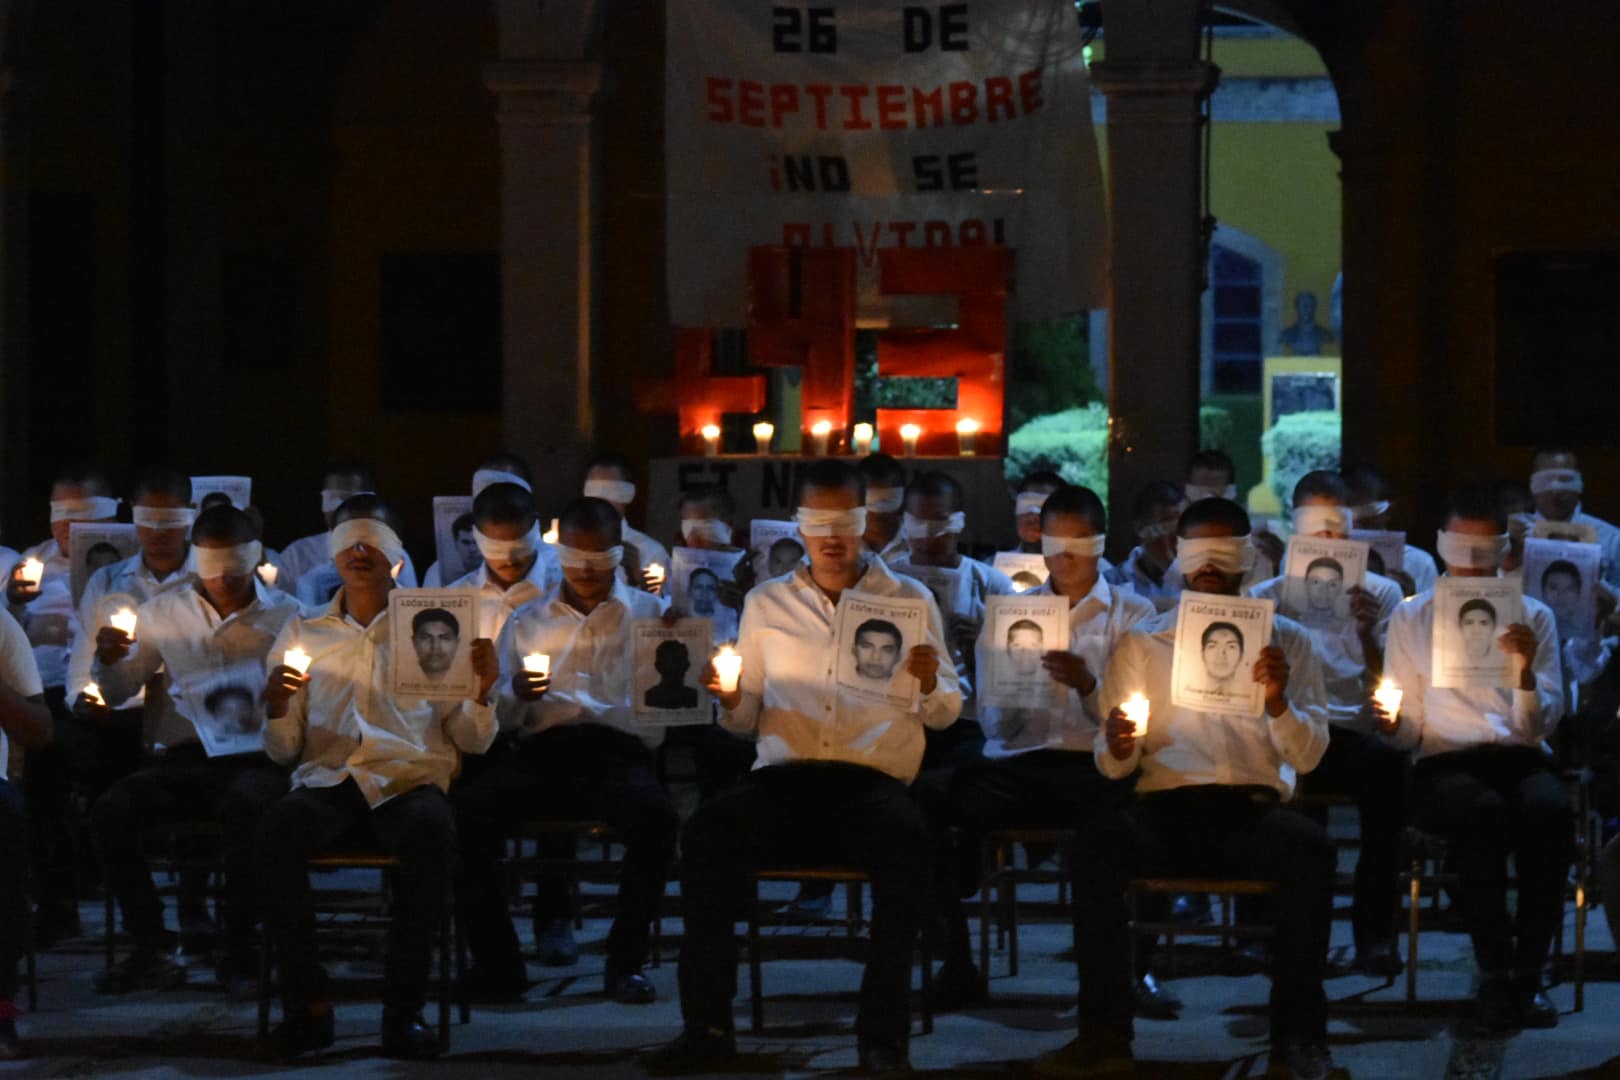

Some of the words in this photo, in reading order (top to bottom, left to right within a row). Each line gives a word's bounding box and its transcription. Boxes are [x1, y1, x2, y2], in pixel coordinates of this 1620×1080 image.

[771, 7, 837, 53] 26
[903, 4, 969, 53] DE
[704, 69, 1044, 131] SEPTIEMBRE
[912, 152, 979, 192] SE
